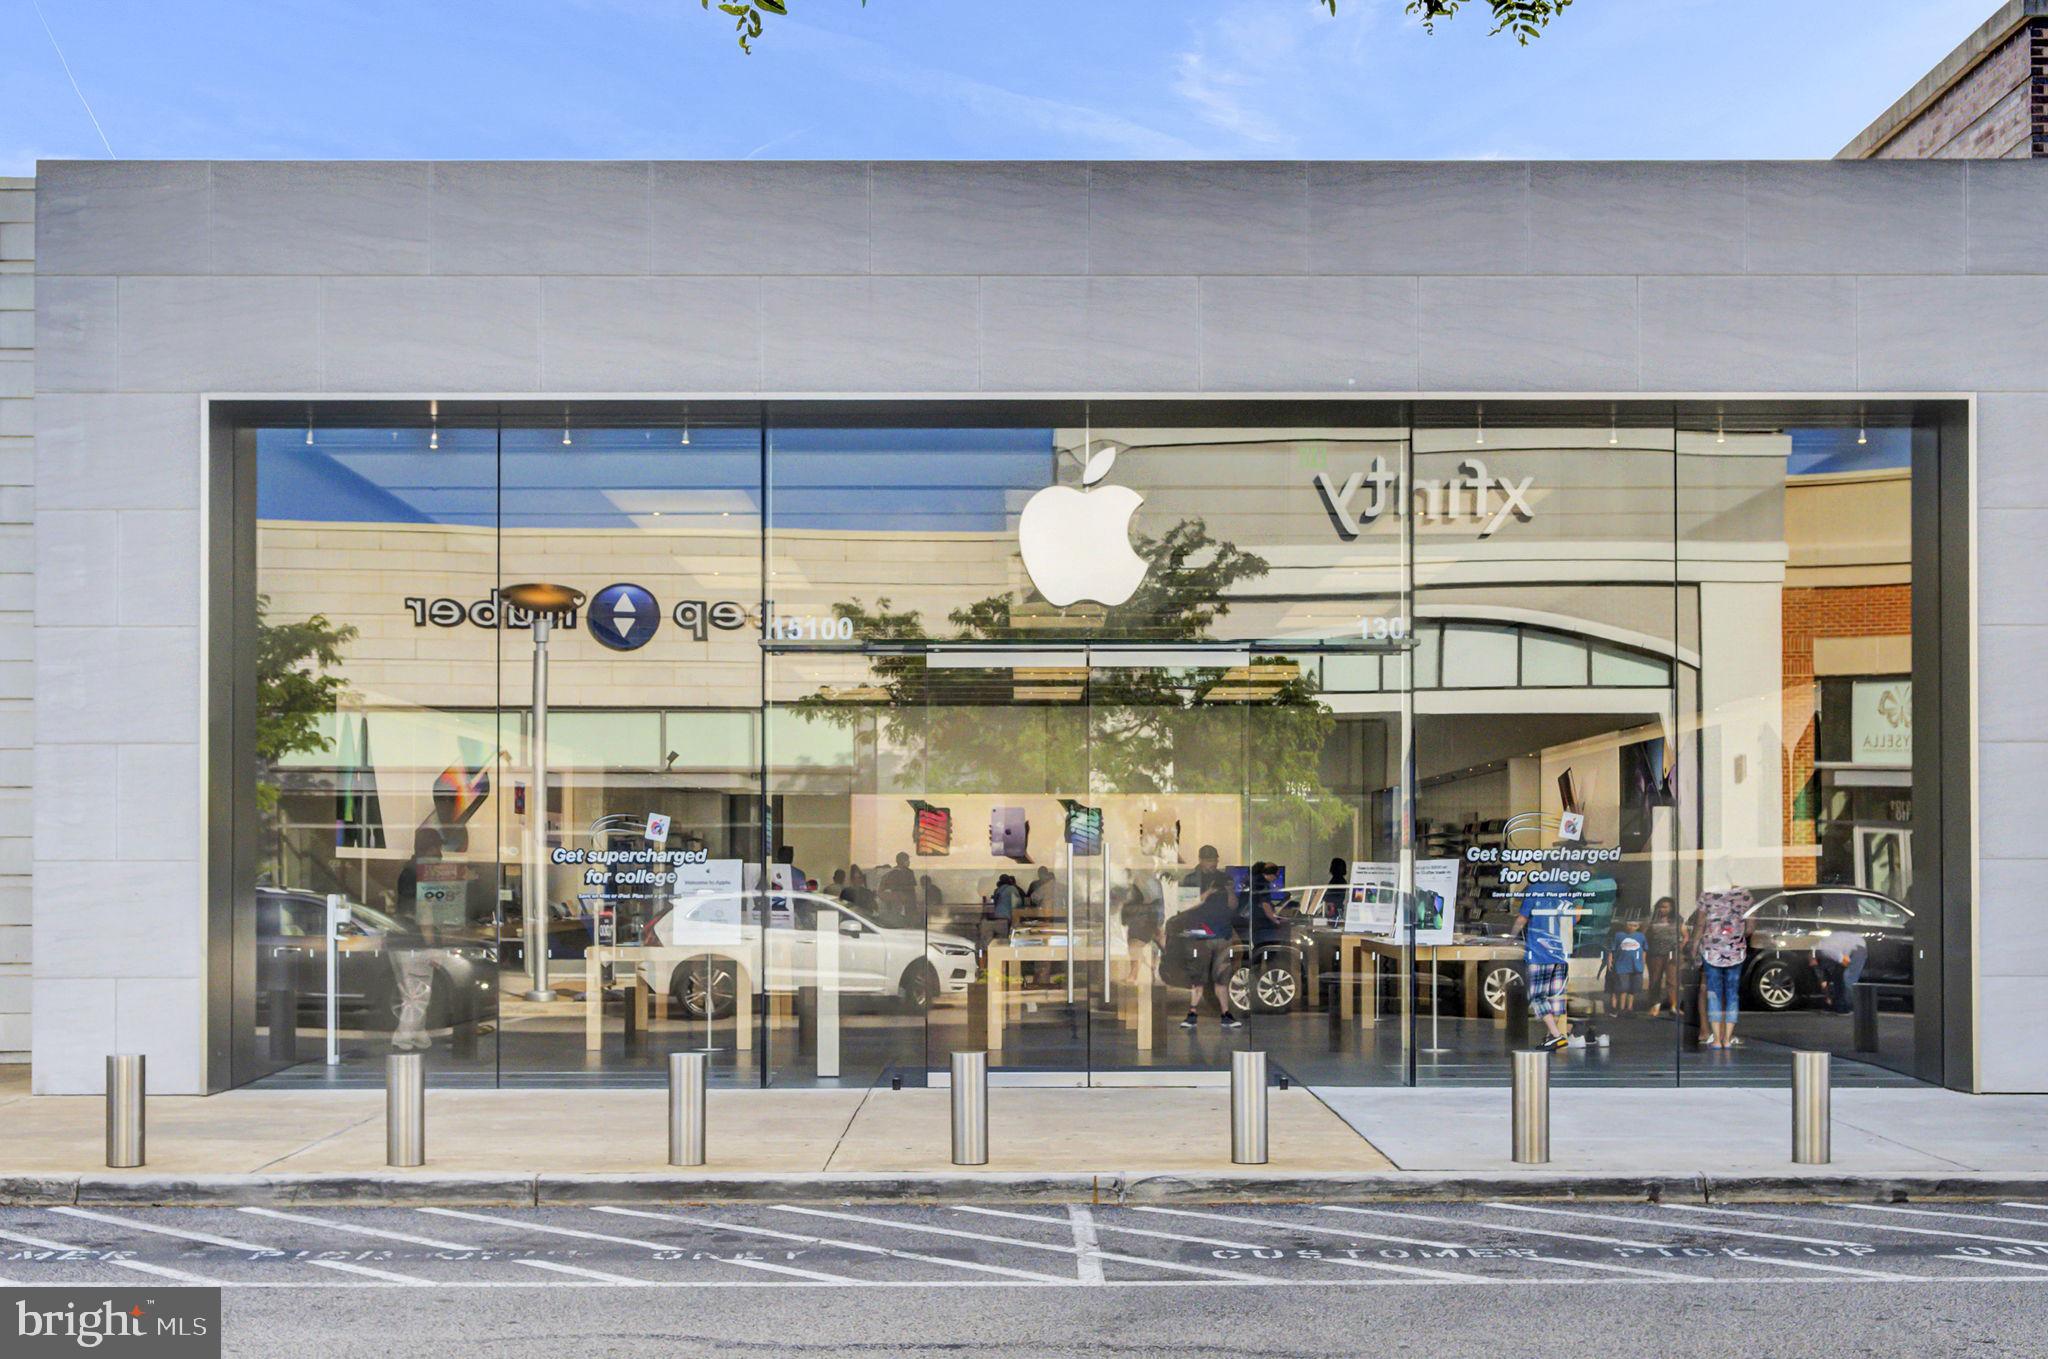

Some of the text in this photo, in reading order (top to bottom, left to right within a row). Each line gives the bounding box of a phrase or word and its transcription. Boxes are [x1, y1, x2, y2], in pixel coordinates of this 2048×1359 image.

[774, 616, 854, 640] 15100
[1358, 616, 1405, 640] 130
[552, 847, 707, 867] Get supercharged
[1466, 846, 1621, 866] Get supercharged
[585, 869, 678, 887] for college
[1499, 868, 1591, 887] for college
[1546, 891, 1558, 899] Plus
[0, 1250, 138, 1261] MER
[1211, 1248, 1540, 1260] CUSTOMER
